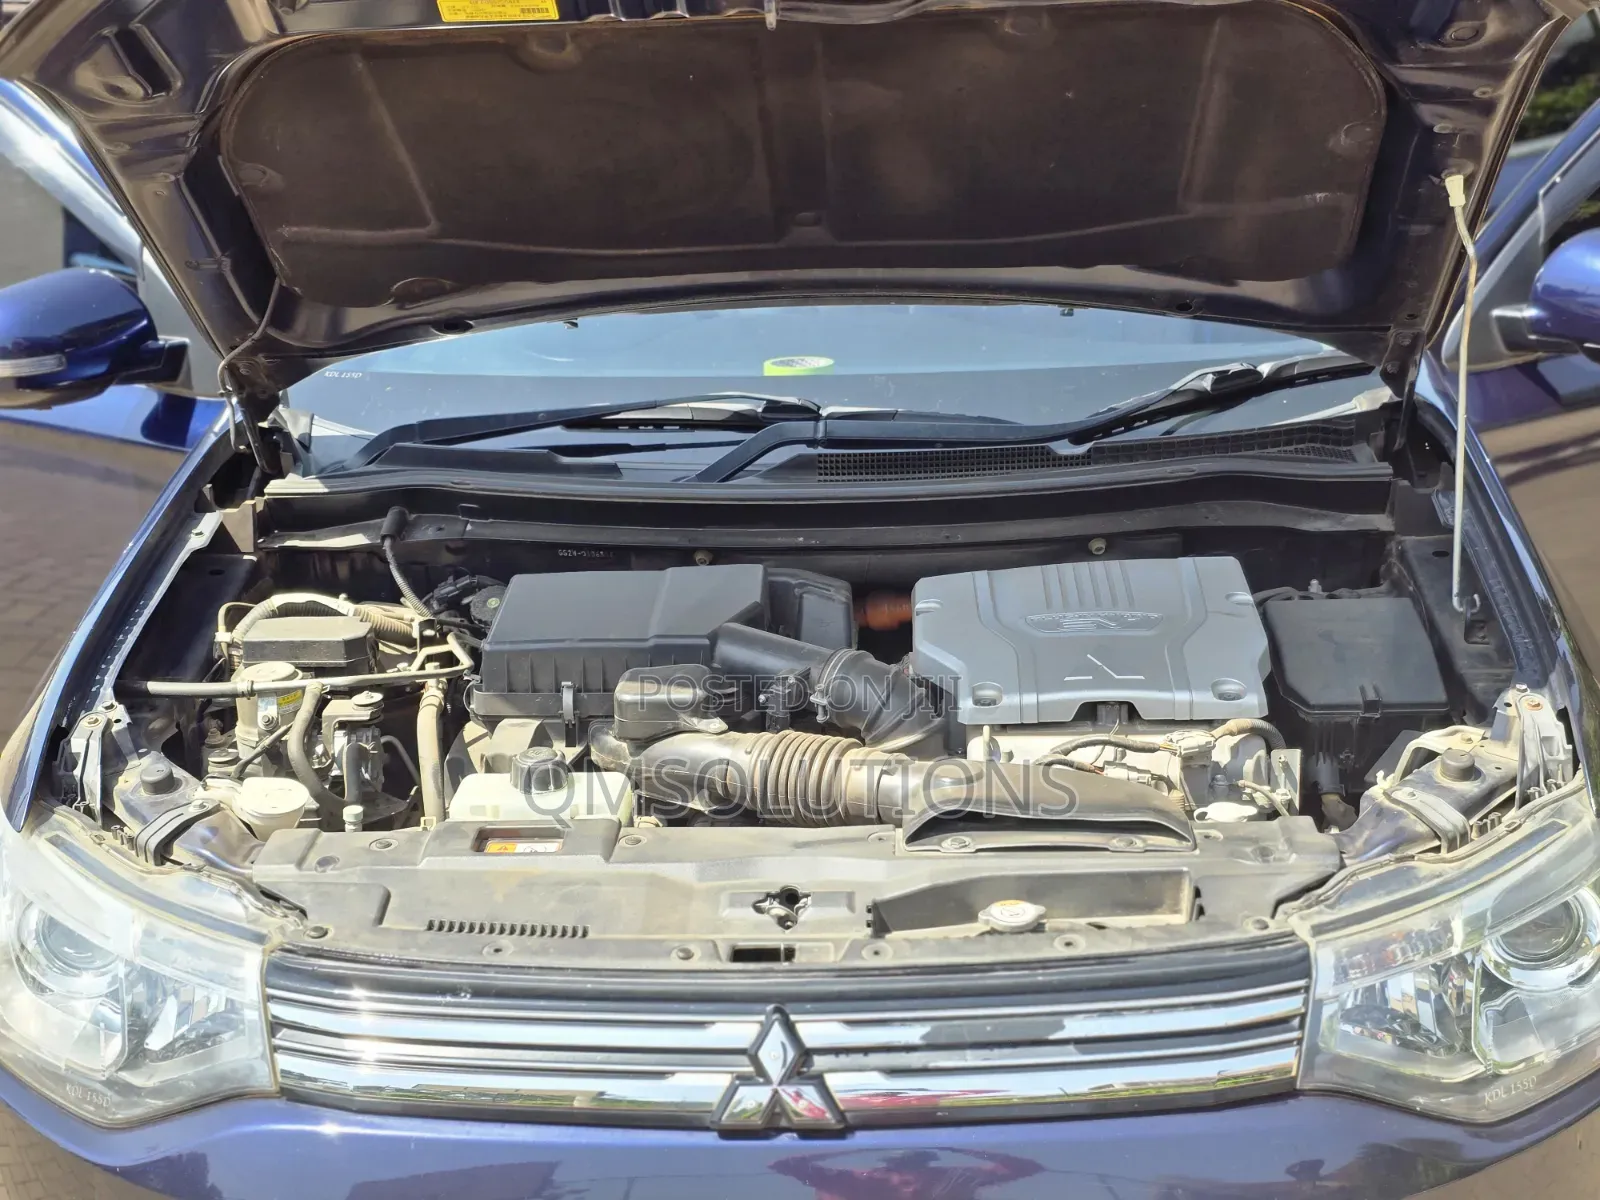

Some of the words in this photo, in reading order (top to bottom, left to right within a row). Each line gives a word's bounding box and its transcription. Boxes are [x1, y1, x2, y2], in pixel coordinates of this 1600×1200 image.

[66, 1082, 83, 1099] KDL
[1484, 1085, 1507, 1106] KDL
[1510, 1075, 1537, 1095] 155D
